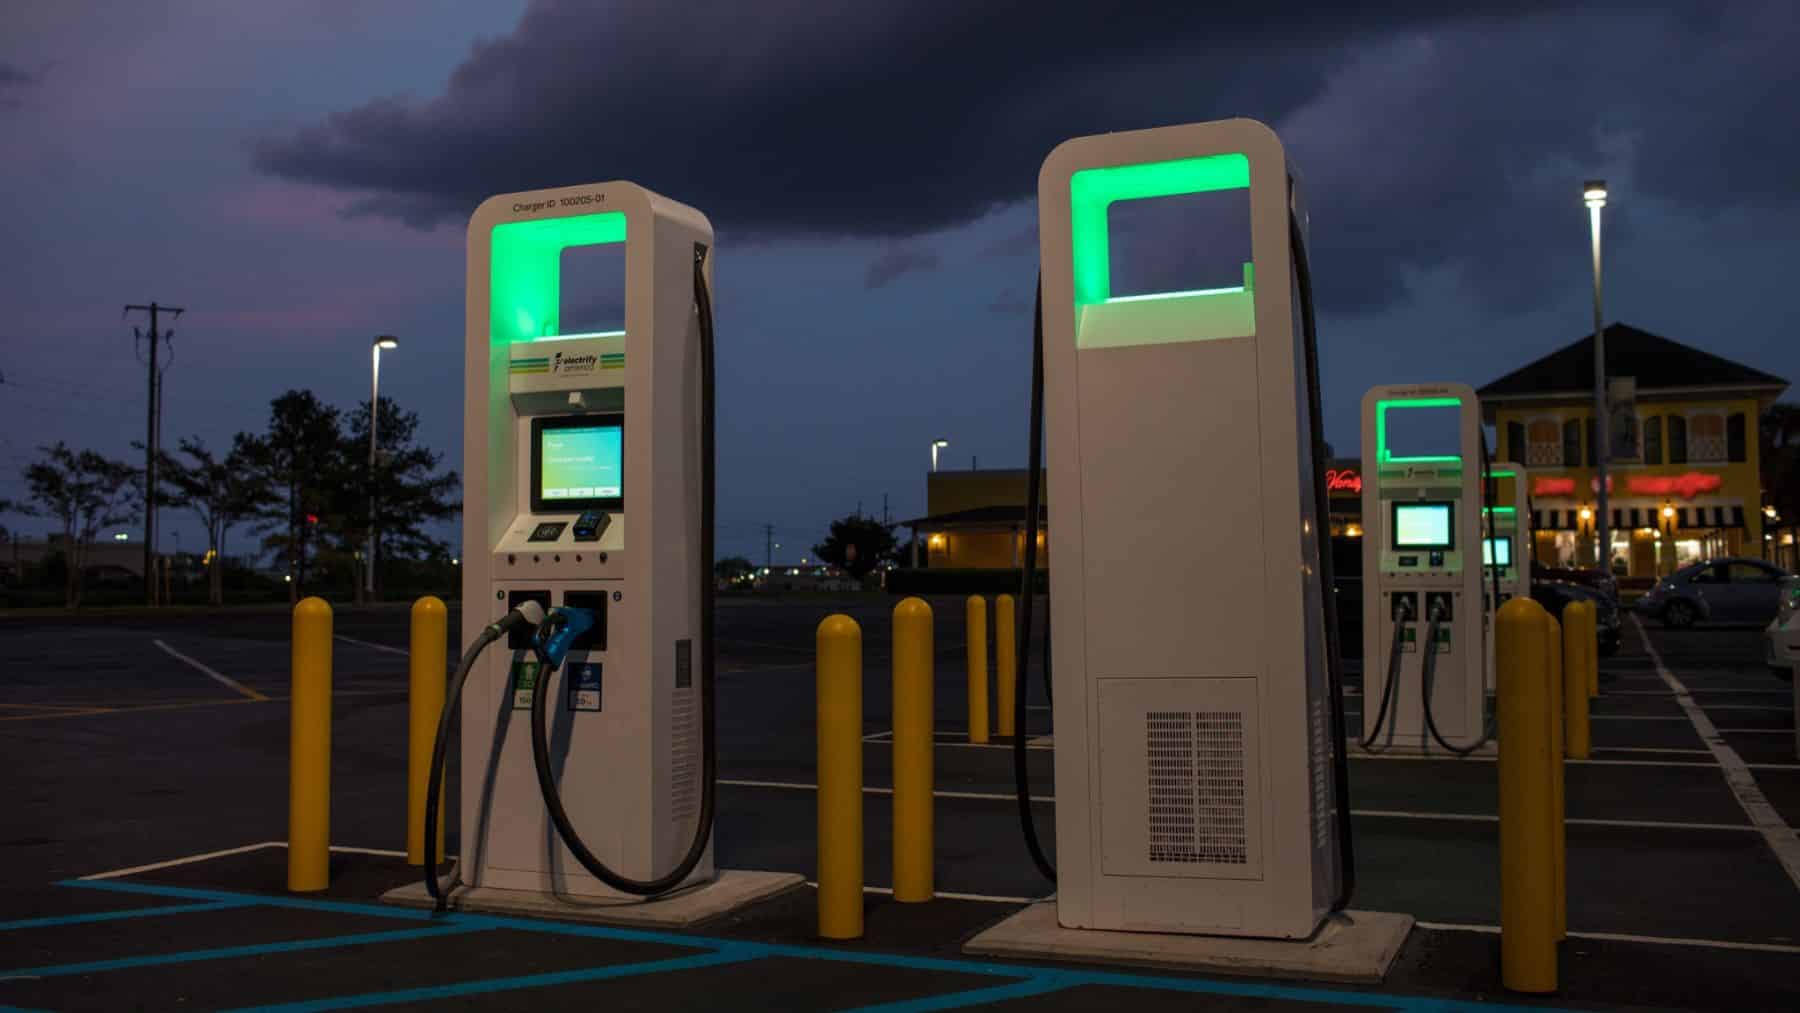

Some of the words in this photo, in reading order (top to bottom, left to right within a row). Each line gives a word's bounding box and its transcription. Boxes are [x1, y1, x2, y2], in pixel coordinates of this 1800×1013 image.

[512, 201, 545, 213] Charger
[547, 199, 556, 208] ID
[564, 354, 597, 367] electrify
